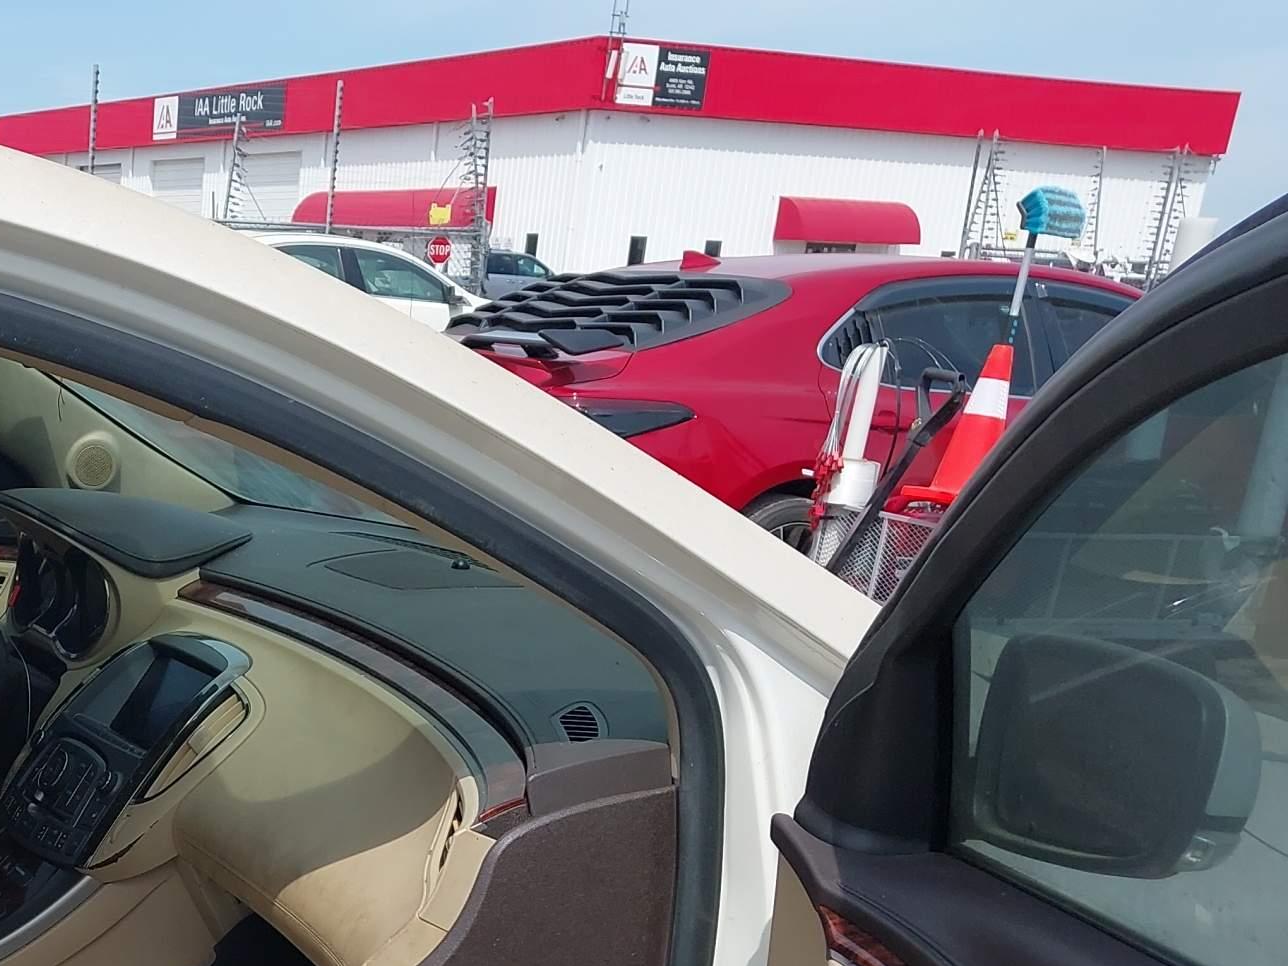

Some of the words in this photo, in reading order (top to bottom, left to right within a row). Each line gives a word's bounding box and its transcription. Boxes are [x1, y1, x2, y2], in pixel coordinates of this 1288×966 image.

[668, 51, 700, 63] Insurance
[660, 62, 675, 72] Auto
[676, 62, 706, 75] Auctions
[194, 97, 210, 116] IAA
[212, 94, 236, 115] Little
[238, 90, 264, 112] Rock
[430, 244, 450, 256] STOP
